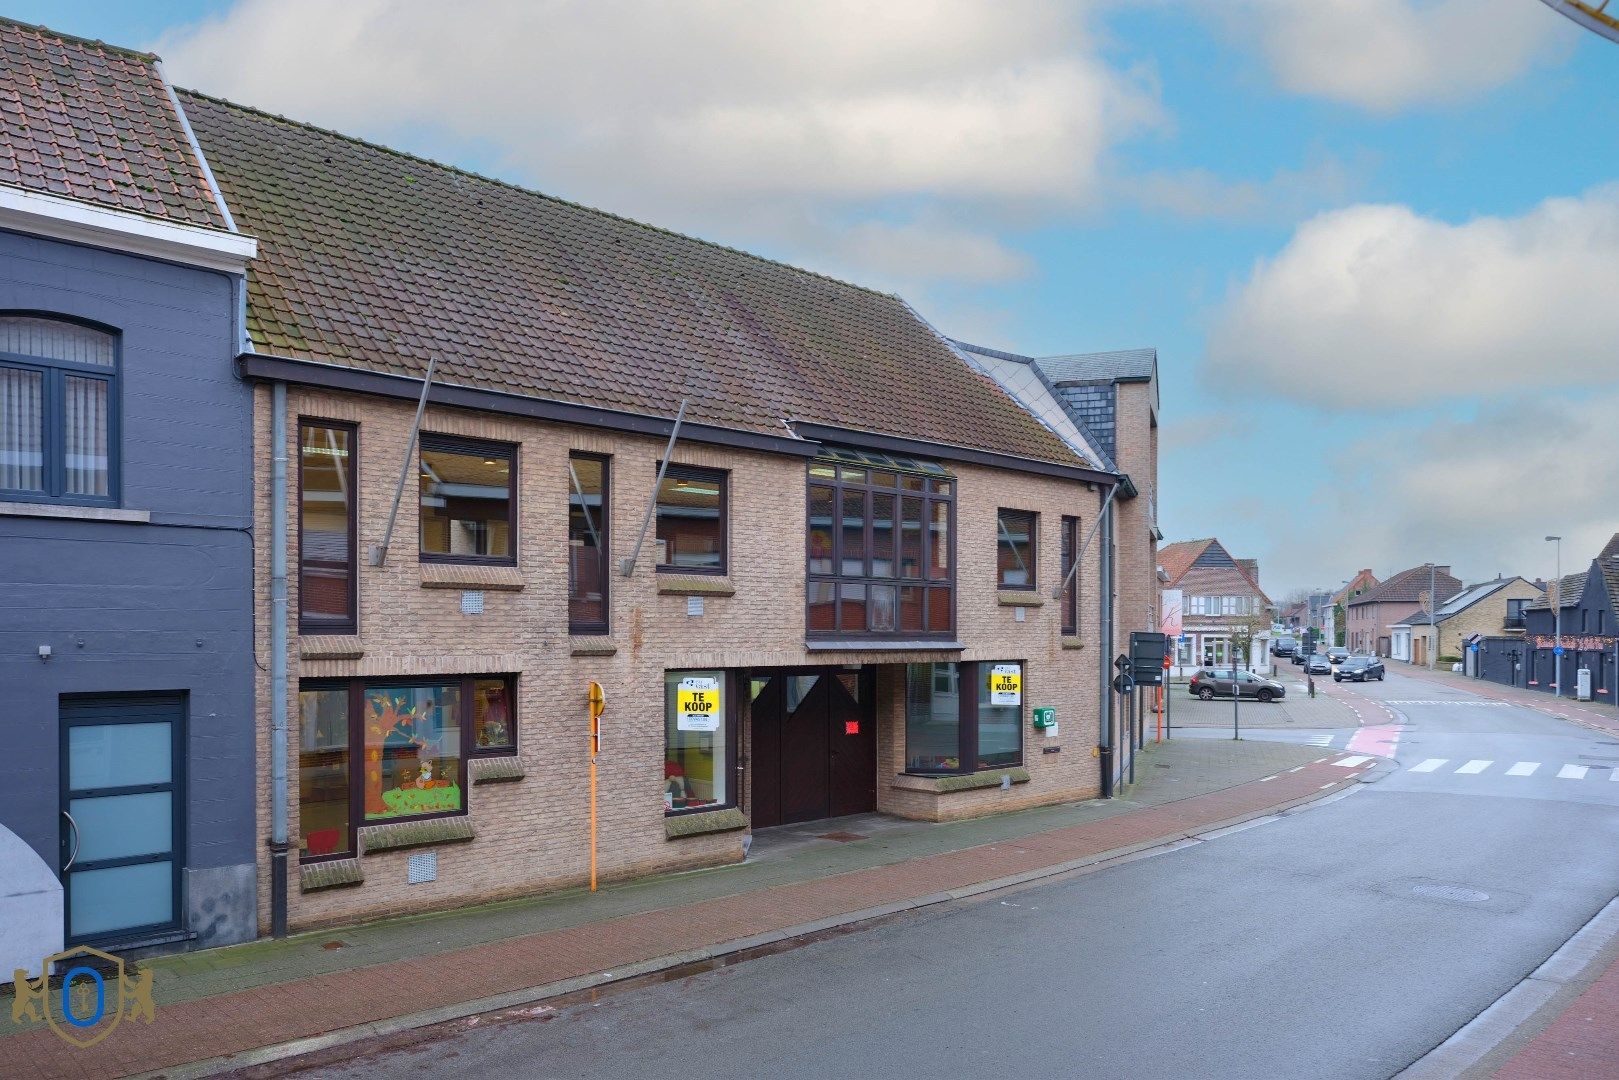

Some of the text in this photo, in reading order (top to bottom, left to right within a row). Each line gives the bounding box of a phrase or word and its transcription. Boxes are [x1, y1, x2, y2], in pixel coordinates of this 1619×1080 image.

[1002, 676, 1012, 684] TE
[996, 683, 1018, 691] KOOP
[692, 692, 704, 702] TE
[684, 702, 712, 712] KOOP
